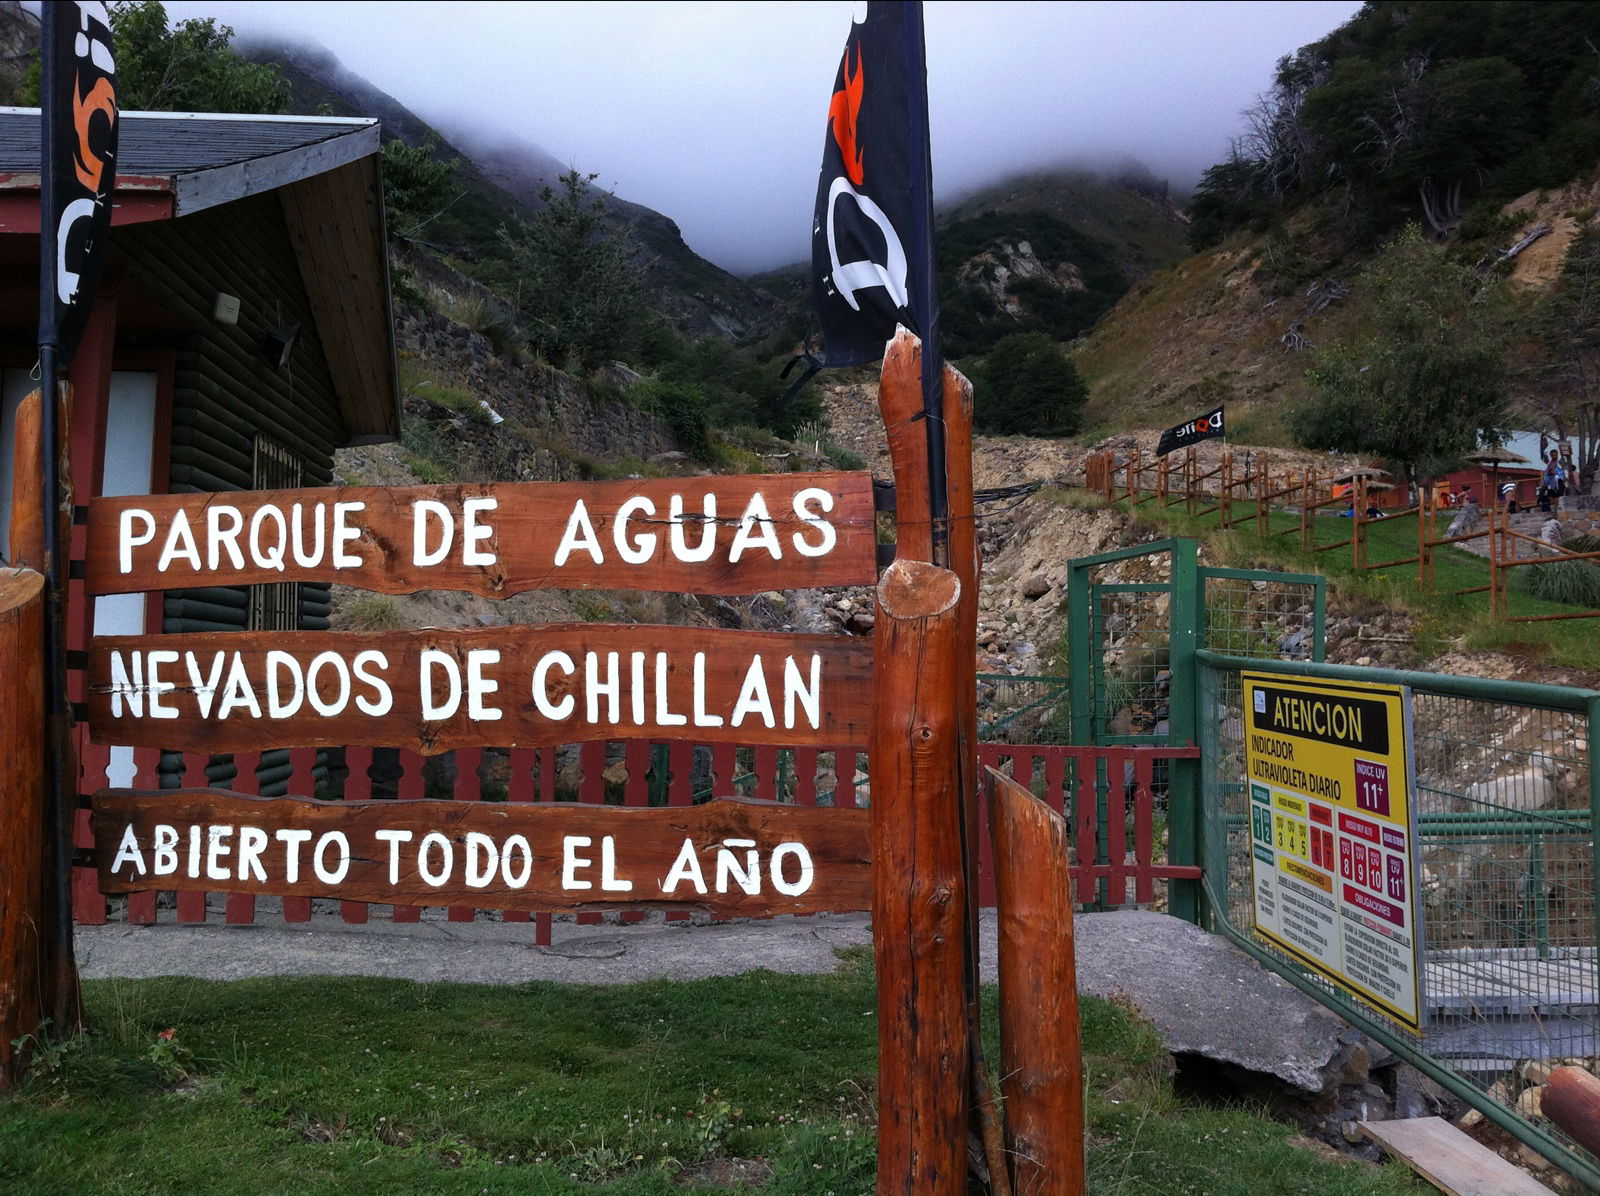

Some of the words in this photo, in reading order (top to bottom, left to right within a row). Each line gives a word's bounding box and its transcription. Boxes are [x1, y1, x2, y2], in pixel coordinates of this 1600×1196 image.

[119, 501, 366, 574] PARQUE
[411, 497, 498, 569] DE
[554, 488, 837, 567] AGUAS
[109, 649, 393, 721] NEVADOS
[419, 648, 503, 722] DE
[531, 650, 822, 730] CHILLAN
[1273, 696, 1363, 743] ATENCION
[1251, 733, 1295, 761] INDICADOR
[1252, 758, 1308, 791] ULTRAVIOLETA
[1309, 774, 1341, 800] DIARIO
[1356, 763, 1375, 778] INDICE
[1375, 768, 1386, 780] UV
[1278, 831, 1283, 847] 3
[1289, 836, 1295, 851] 4
[1301, 840, 1306, 856] 5
[110, 823, 351, 885] ABIERTO
[375, 829, 533, 891] TODO
[561, 835, 633, 892] EL
[661, 837, 814, 897] AÑO
[1344, 858, 1350, 875] 8
[1358, 864, 1364, 882] 9
[1371, 870, 1380, 888] 10
